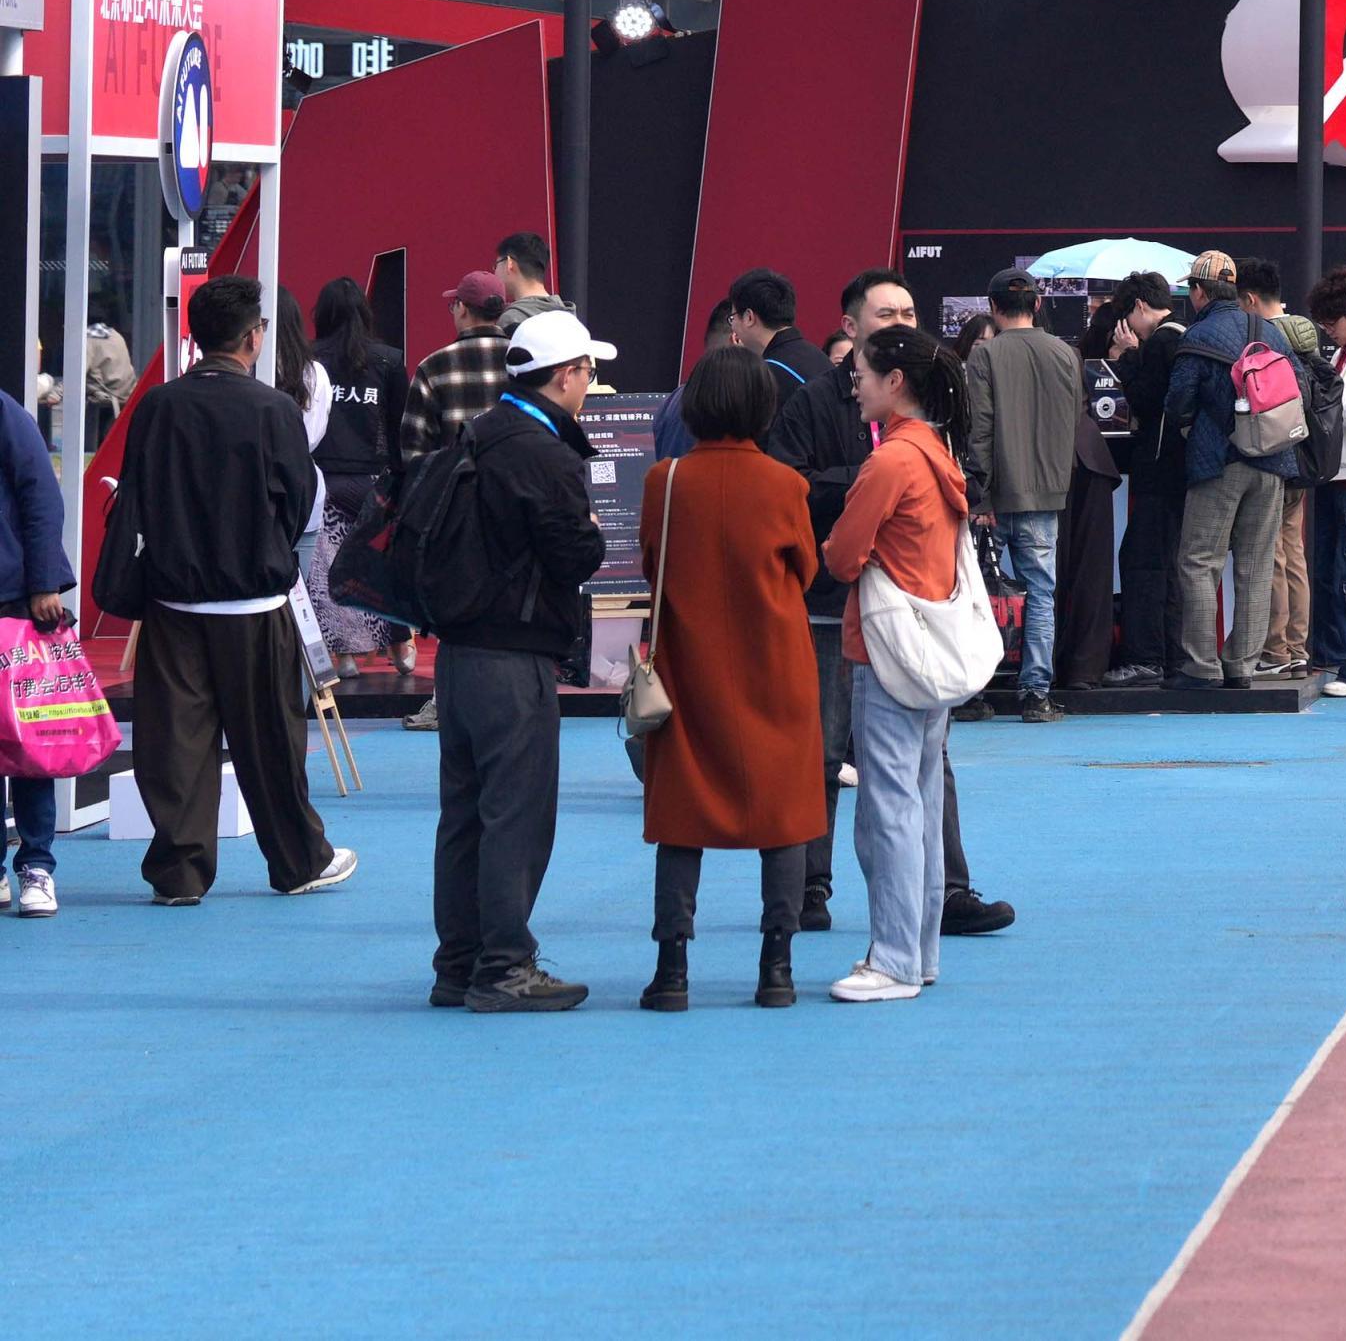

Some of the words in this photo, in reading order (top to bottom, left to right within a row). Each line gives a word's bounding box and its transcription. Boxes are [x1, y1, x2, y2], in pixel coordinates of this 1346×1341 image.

[908, 245, 942, 258] AIFUT
[181, 253, 187, 268] AI
[188, 252, 208, 268] FUTURE
